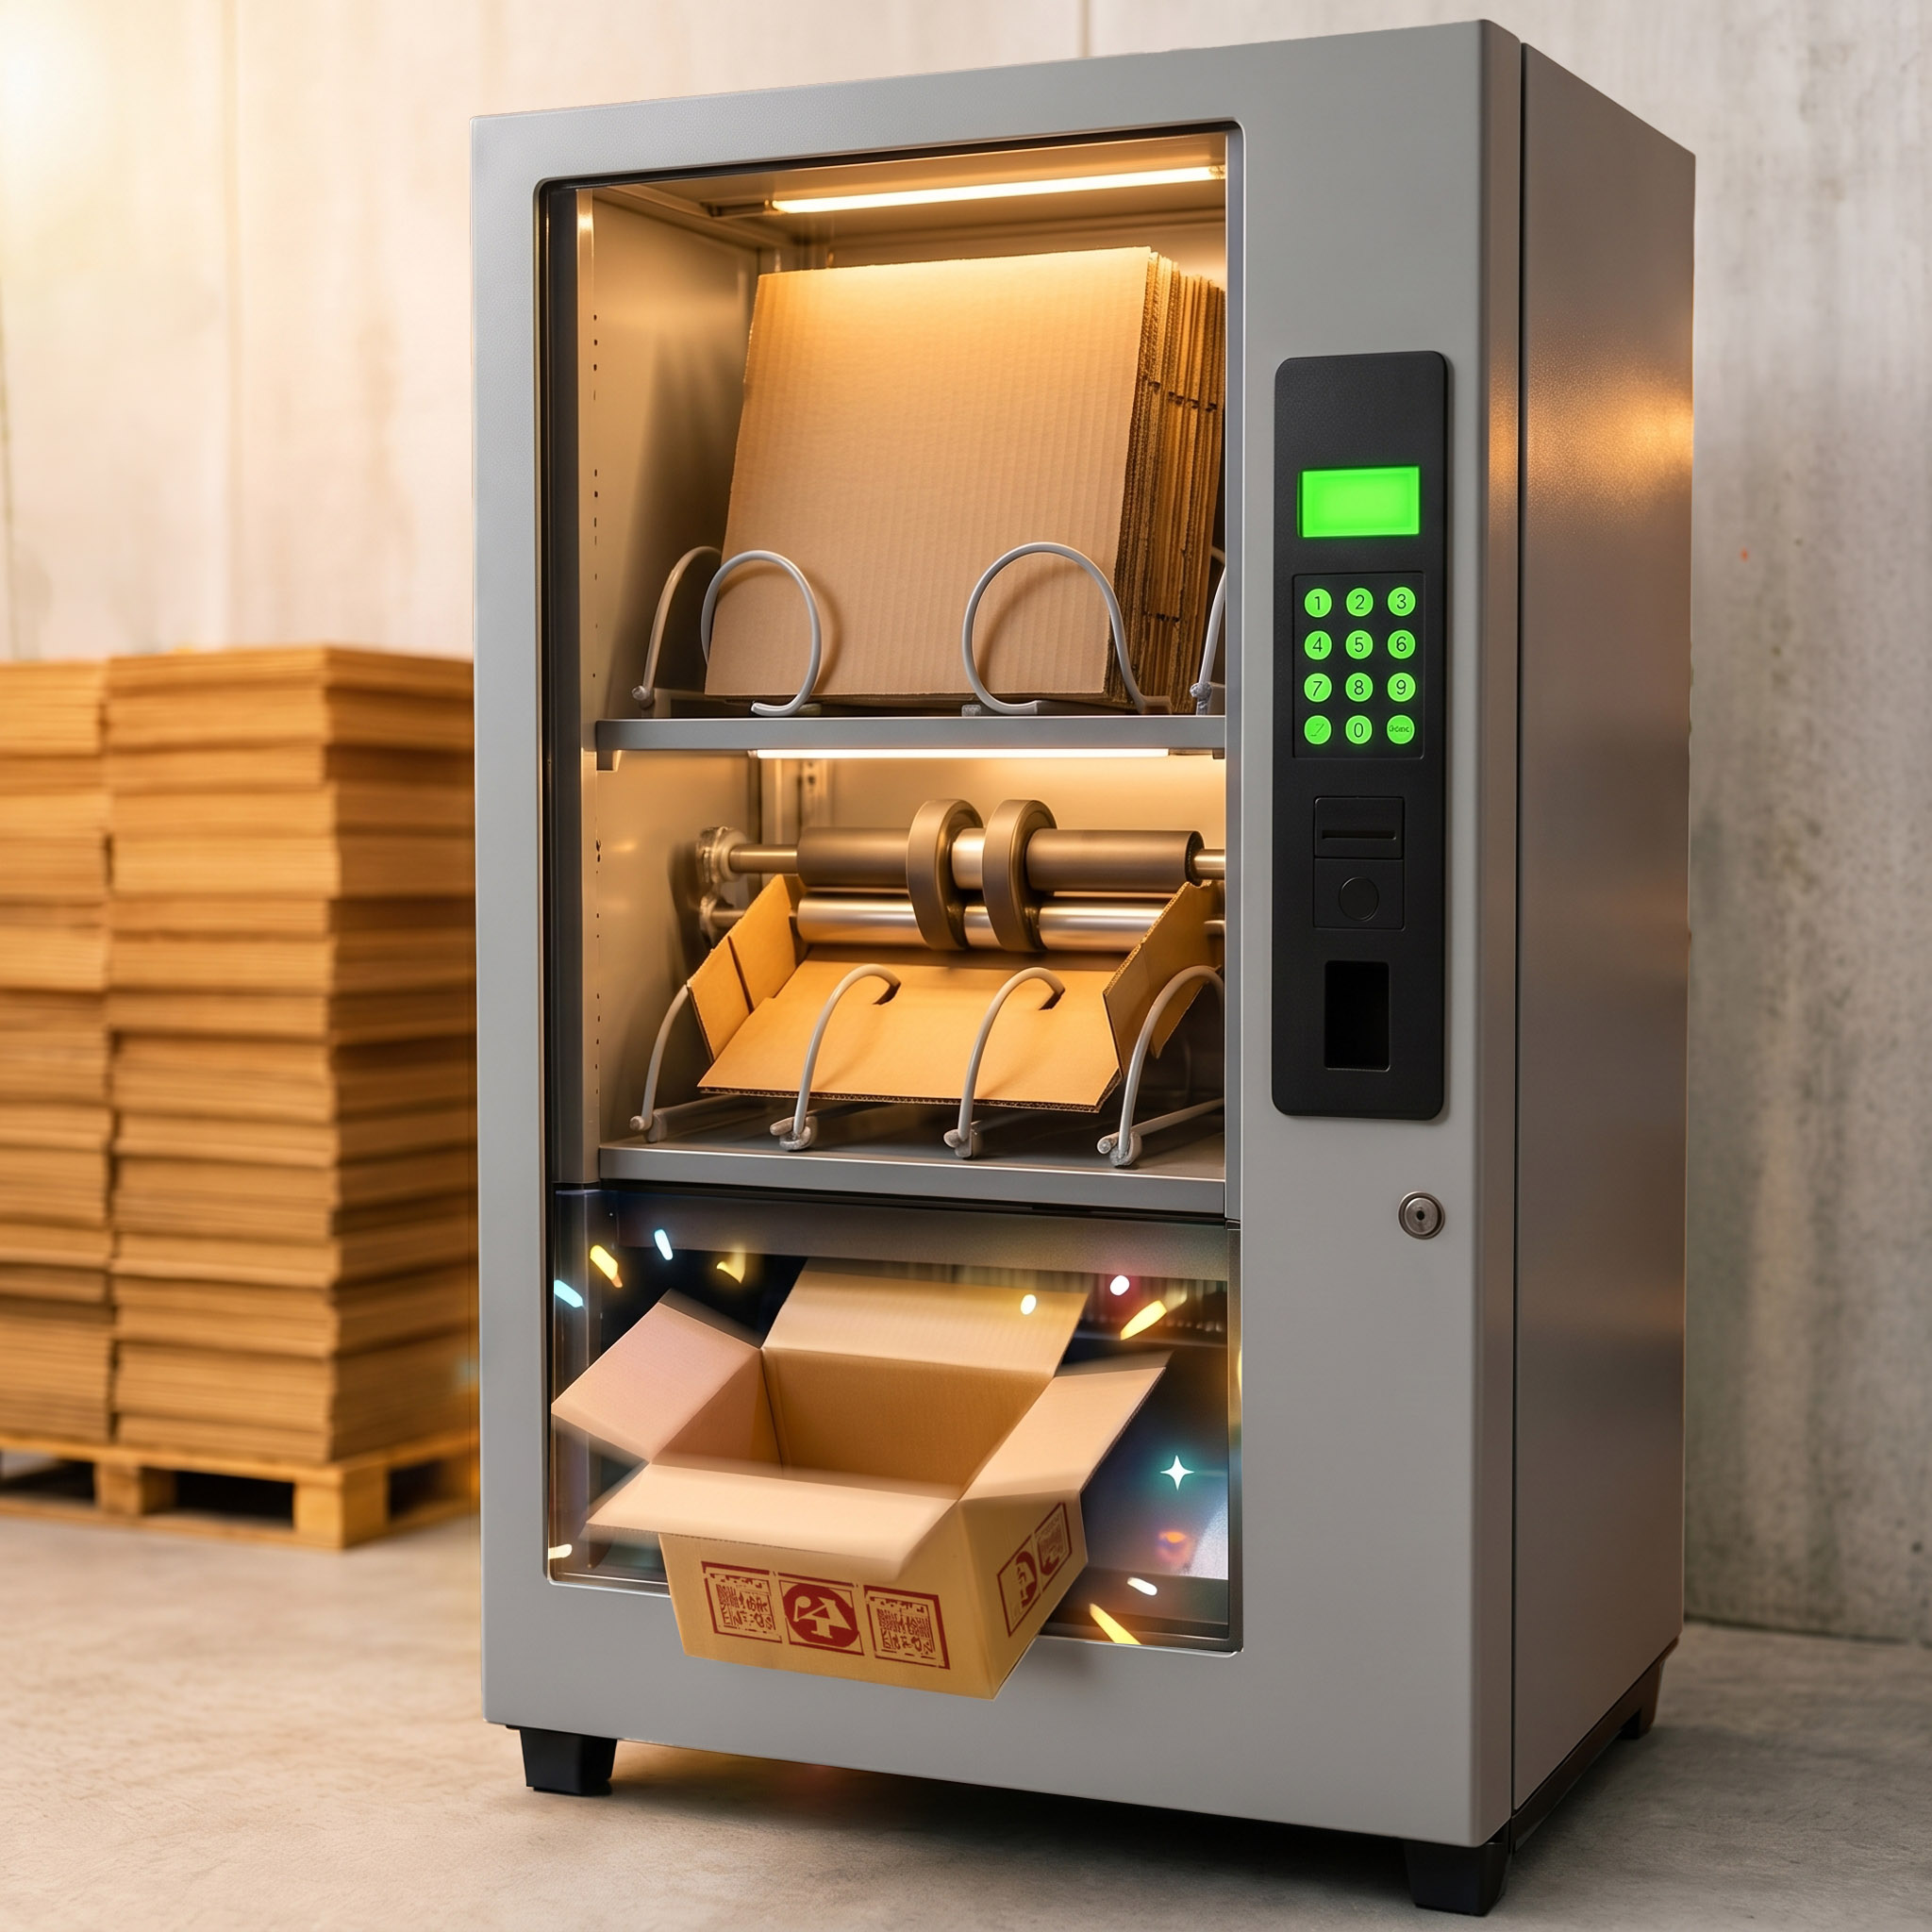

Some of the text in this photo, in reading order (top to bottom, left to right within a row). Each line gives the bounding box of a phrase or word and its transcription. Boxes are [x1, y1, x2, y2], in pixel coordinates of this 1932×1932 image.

[1314, 594, 1407, 610] 1 2 3
[1312, 636, 1407, 652] 4 5 6
[1313, 679, 1406, 696] 7 8 9
[1354, 723, 1363, 738] 0
